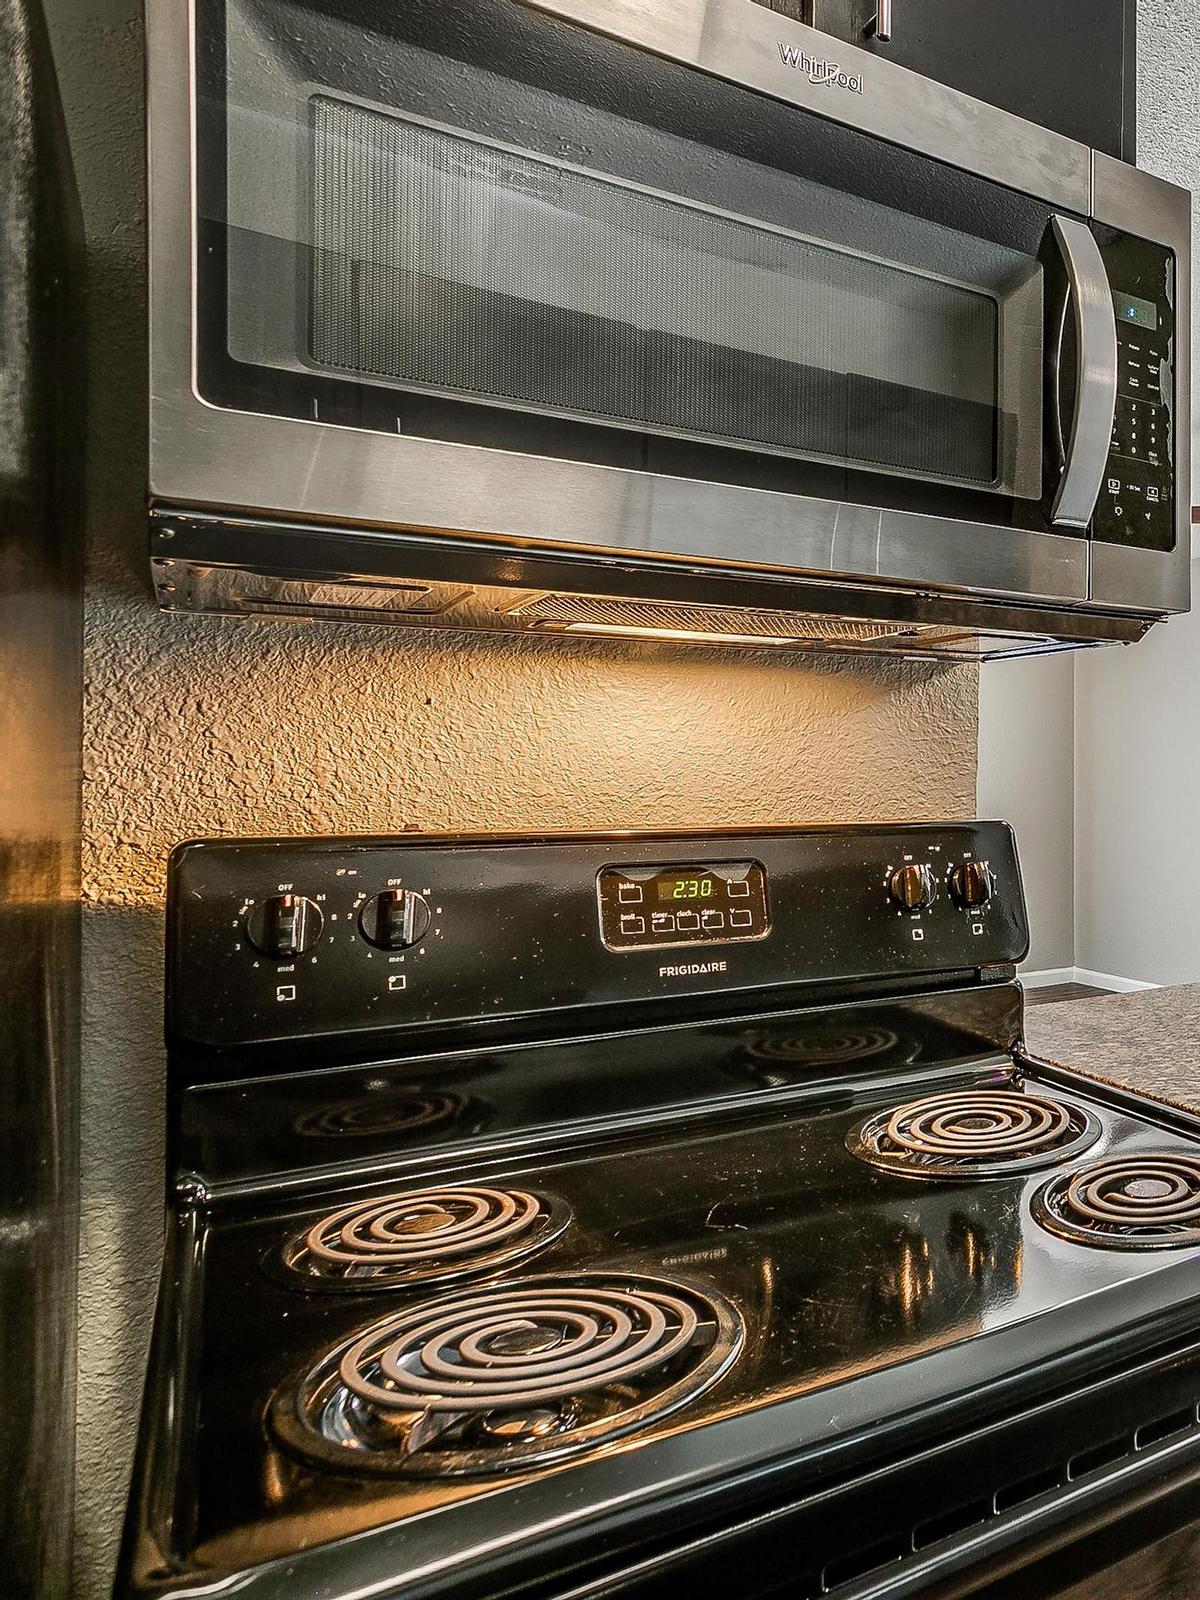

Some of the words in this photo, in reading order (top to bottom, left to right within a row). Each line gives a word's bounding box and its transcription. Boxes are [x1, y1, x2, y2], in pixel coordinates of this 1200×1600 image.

[778, 41, 864, 95] Whirlpool
[388, 955, 405, 963] med
[277, 964, 295, 972] med
[658, 961, 727, 977] FRIGIDAIRE
